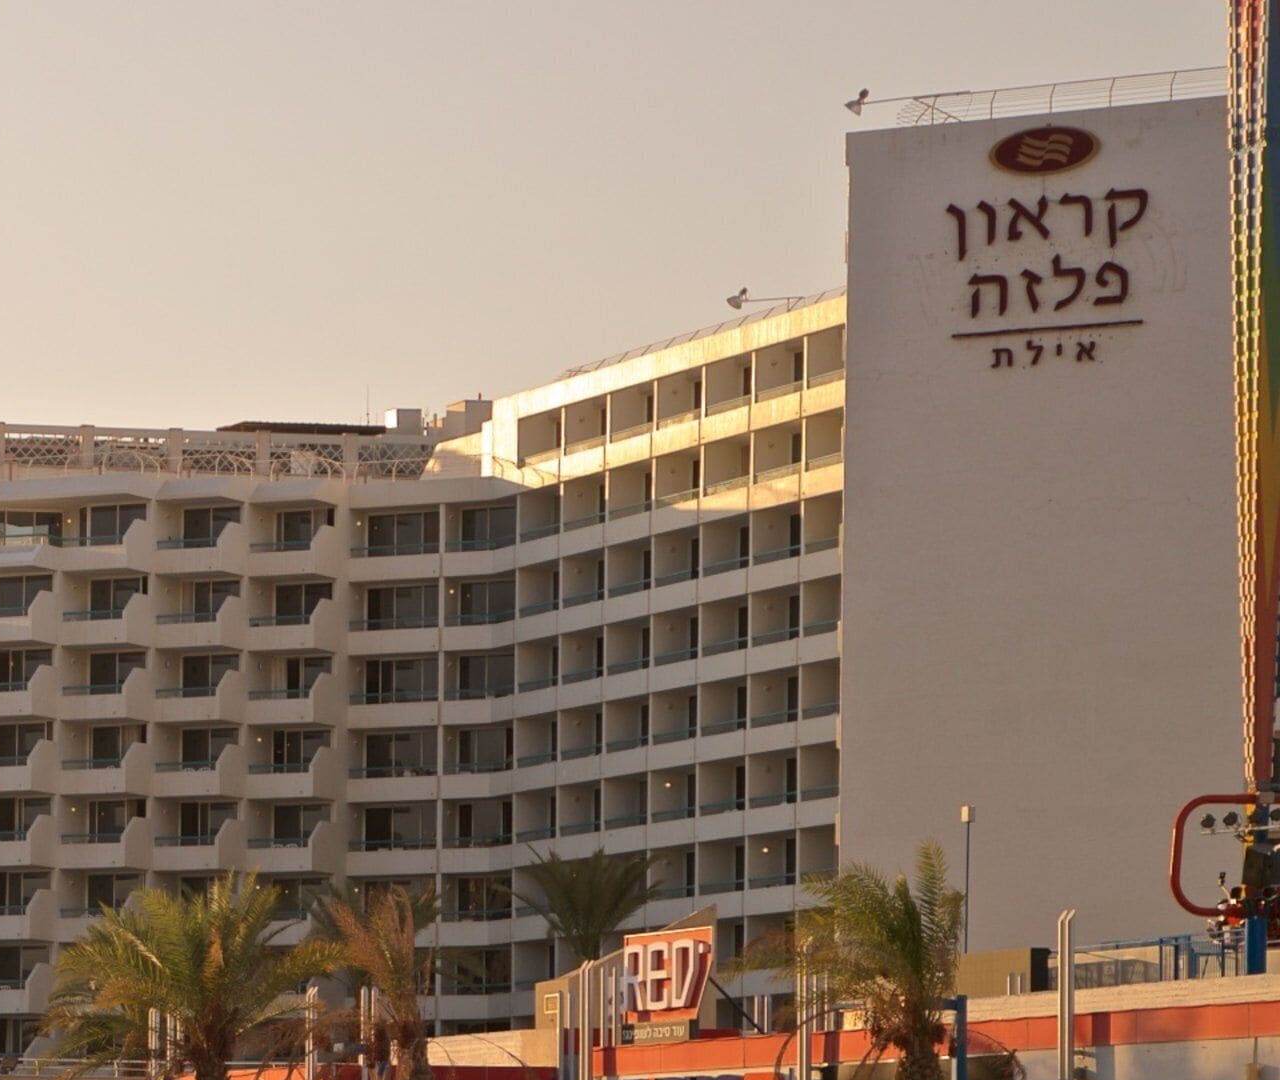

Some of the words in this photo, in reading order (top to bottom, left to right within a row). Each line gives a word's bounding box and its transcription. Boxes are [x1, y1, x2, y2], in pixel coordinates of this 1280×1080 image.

[945, 187, 1150, 262] קראון
[967, 253, 1131, 319] פלזה
[989, 338, 1098, 369] אילת
